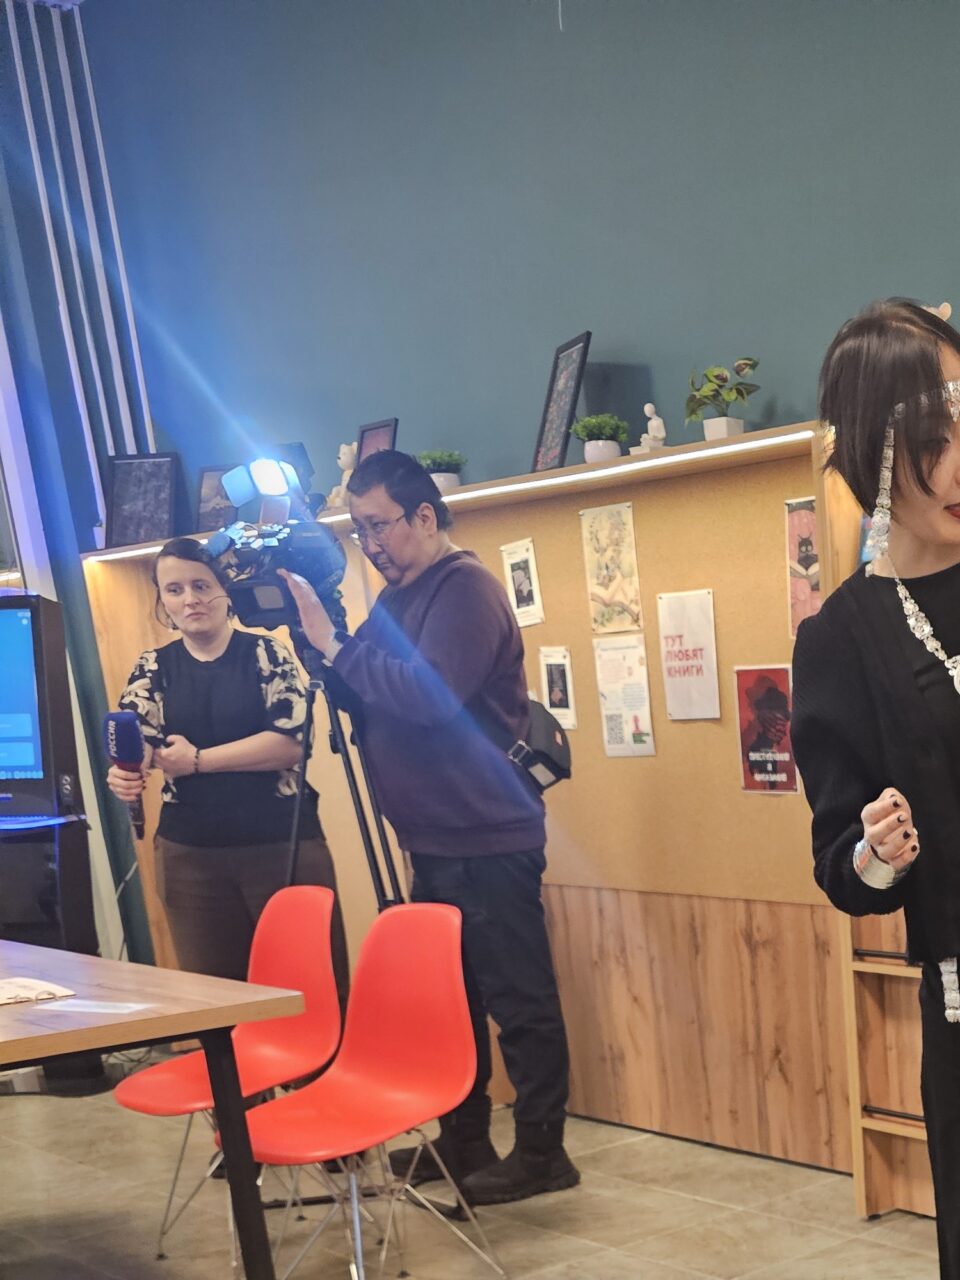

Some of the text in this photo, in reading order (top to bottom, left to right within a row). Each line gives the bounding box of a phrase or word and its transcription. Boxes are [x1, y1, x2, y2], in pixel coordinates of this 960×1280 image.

[663, 634, 683, 648] ТУТ
[665, 648, 704, 662] ЛЮБЯТ
[667, 664, 704, 678] КНИГИ
[108, 720, 118, 757] РОССИЯ
